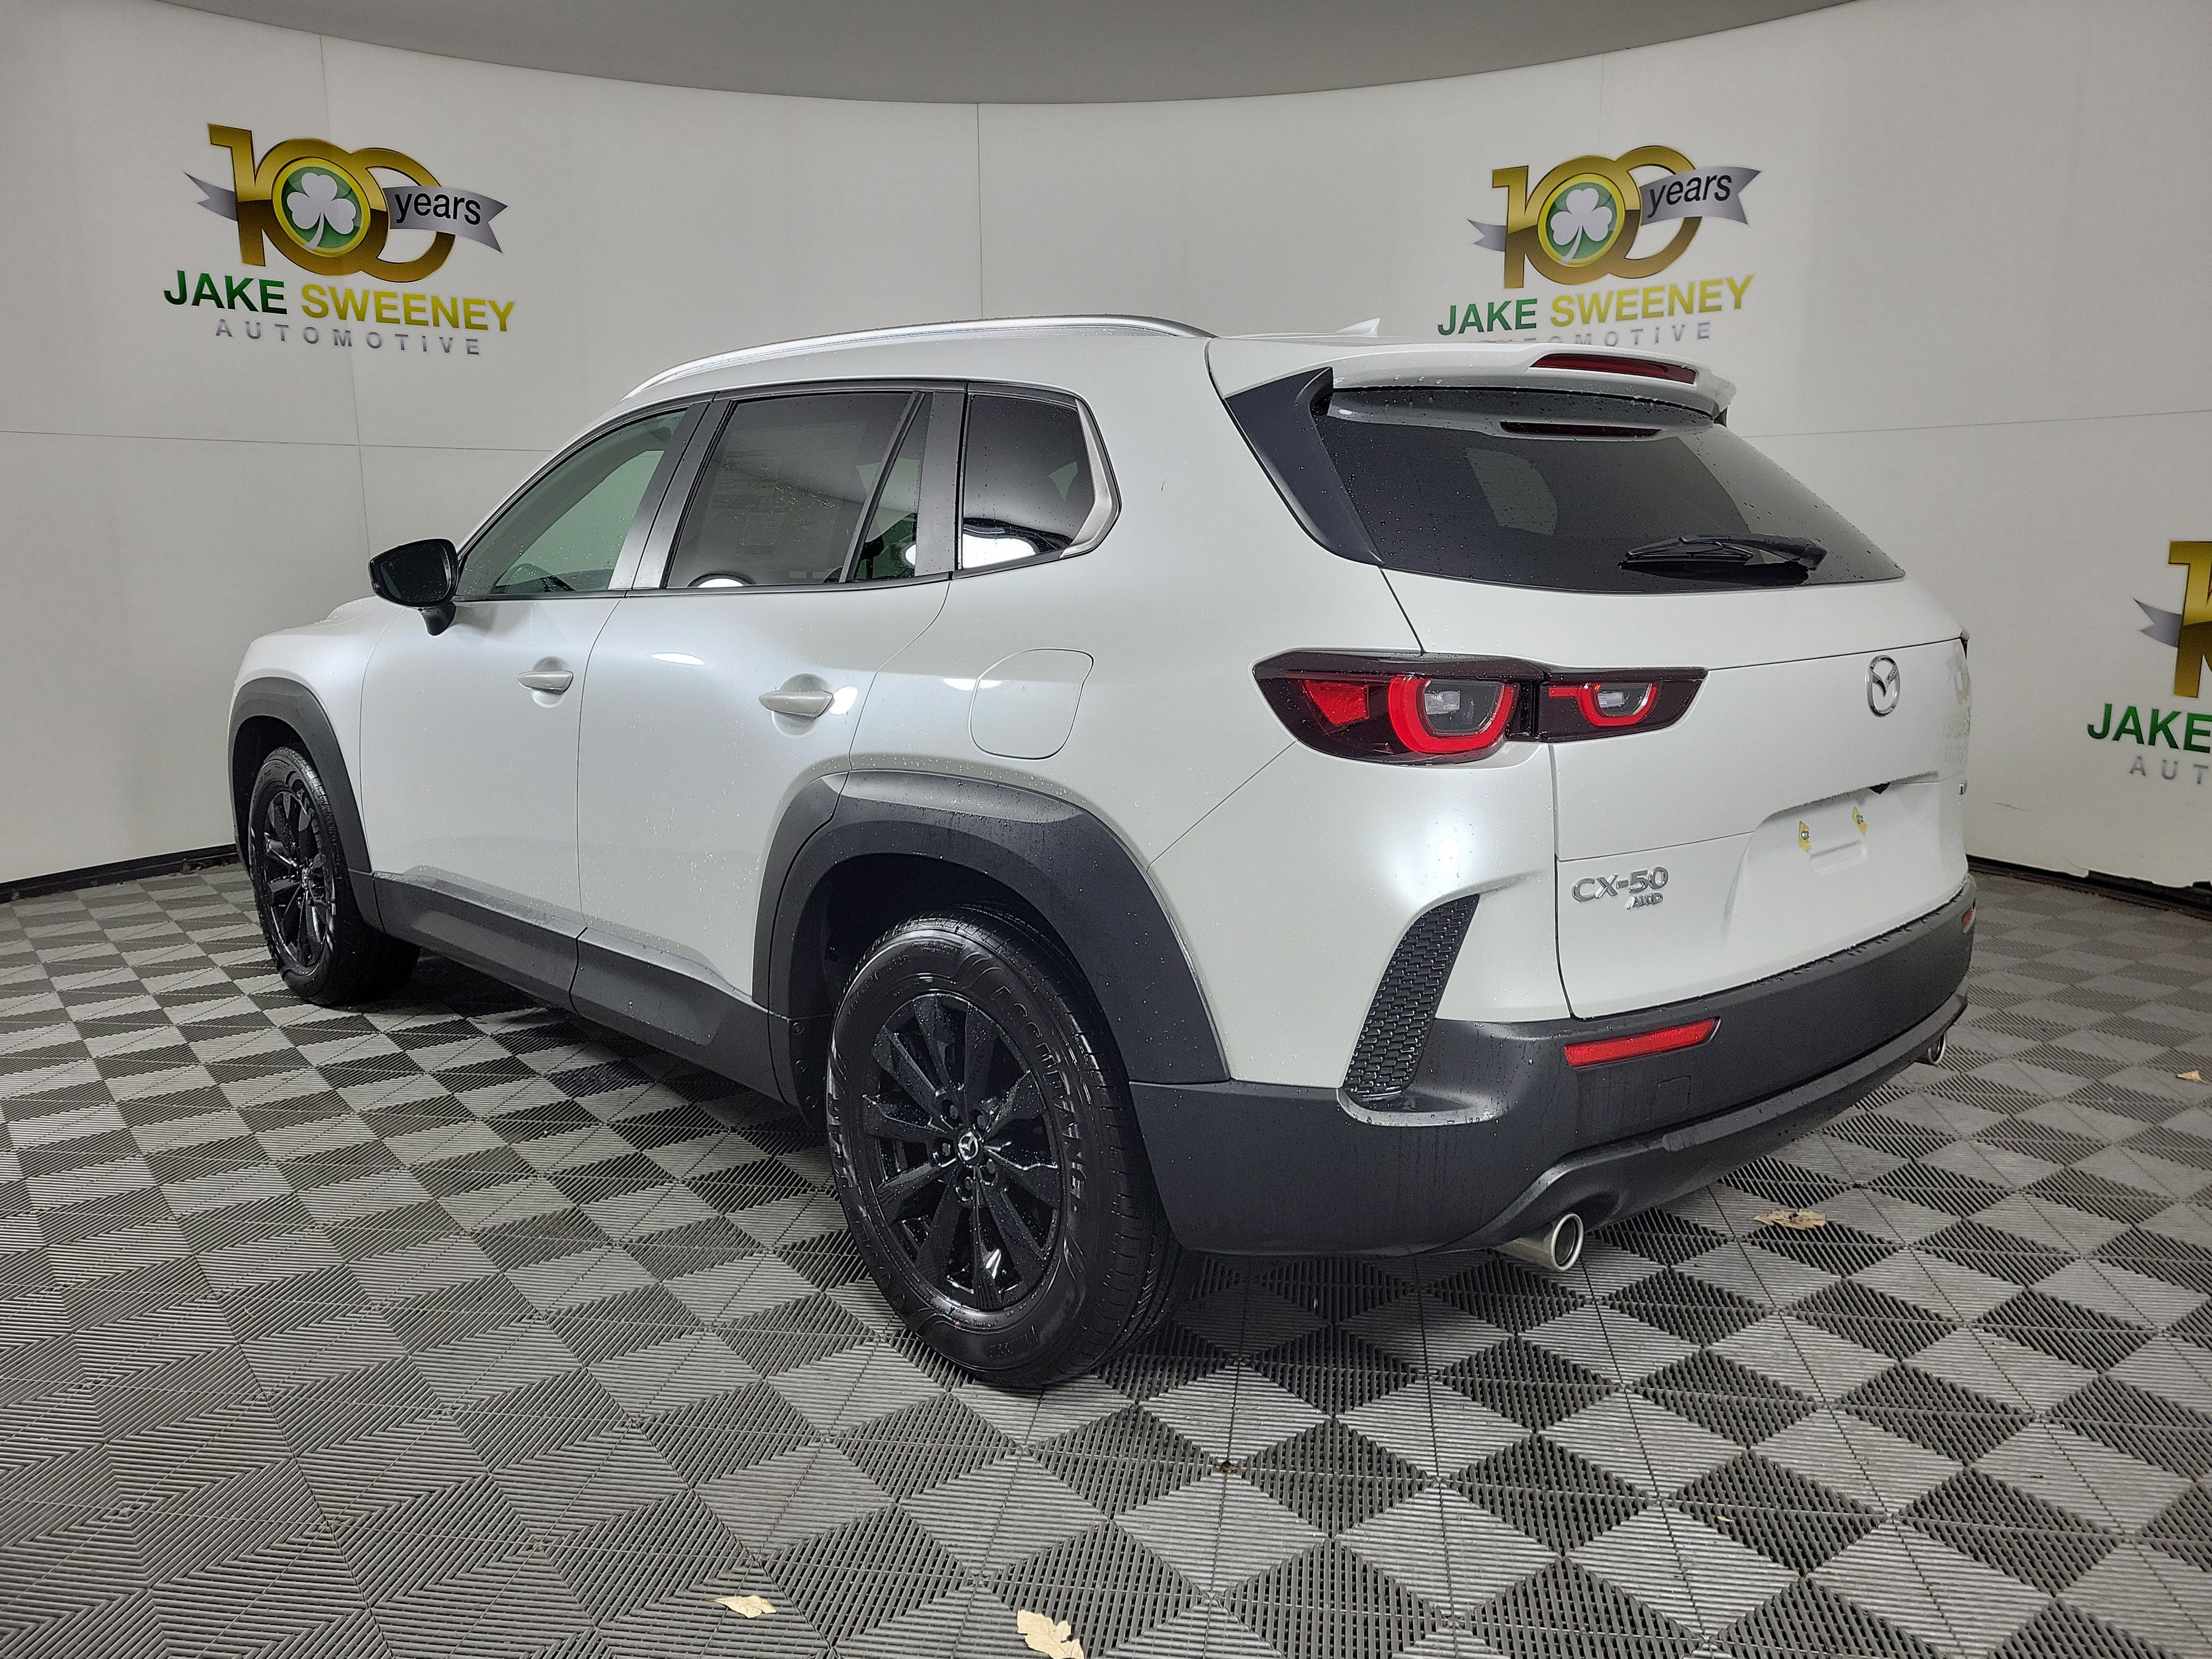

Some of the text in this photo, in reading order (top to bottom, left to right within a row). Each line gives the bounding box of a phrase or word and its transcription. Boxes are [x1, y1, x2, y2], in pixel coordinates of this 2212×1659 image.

[207, 122, 455, 283] 100
[394, 192, 482, 225] years
[1491, 145, 1702, 289] 100
[1647, 173, 1733, 218] years
[163, 270, 515, 332] JAKE SWEENEY
[1437, 274, 1754, 336] JAKE SWEENEY
[215, 318, 480, 355] AUTOMOTIVE
[2087, 703, 2212, 754] JAKE
[1571, 866, 1669, 902] CX-50
[1626, 892, 1664, 910] AWD
